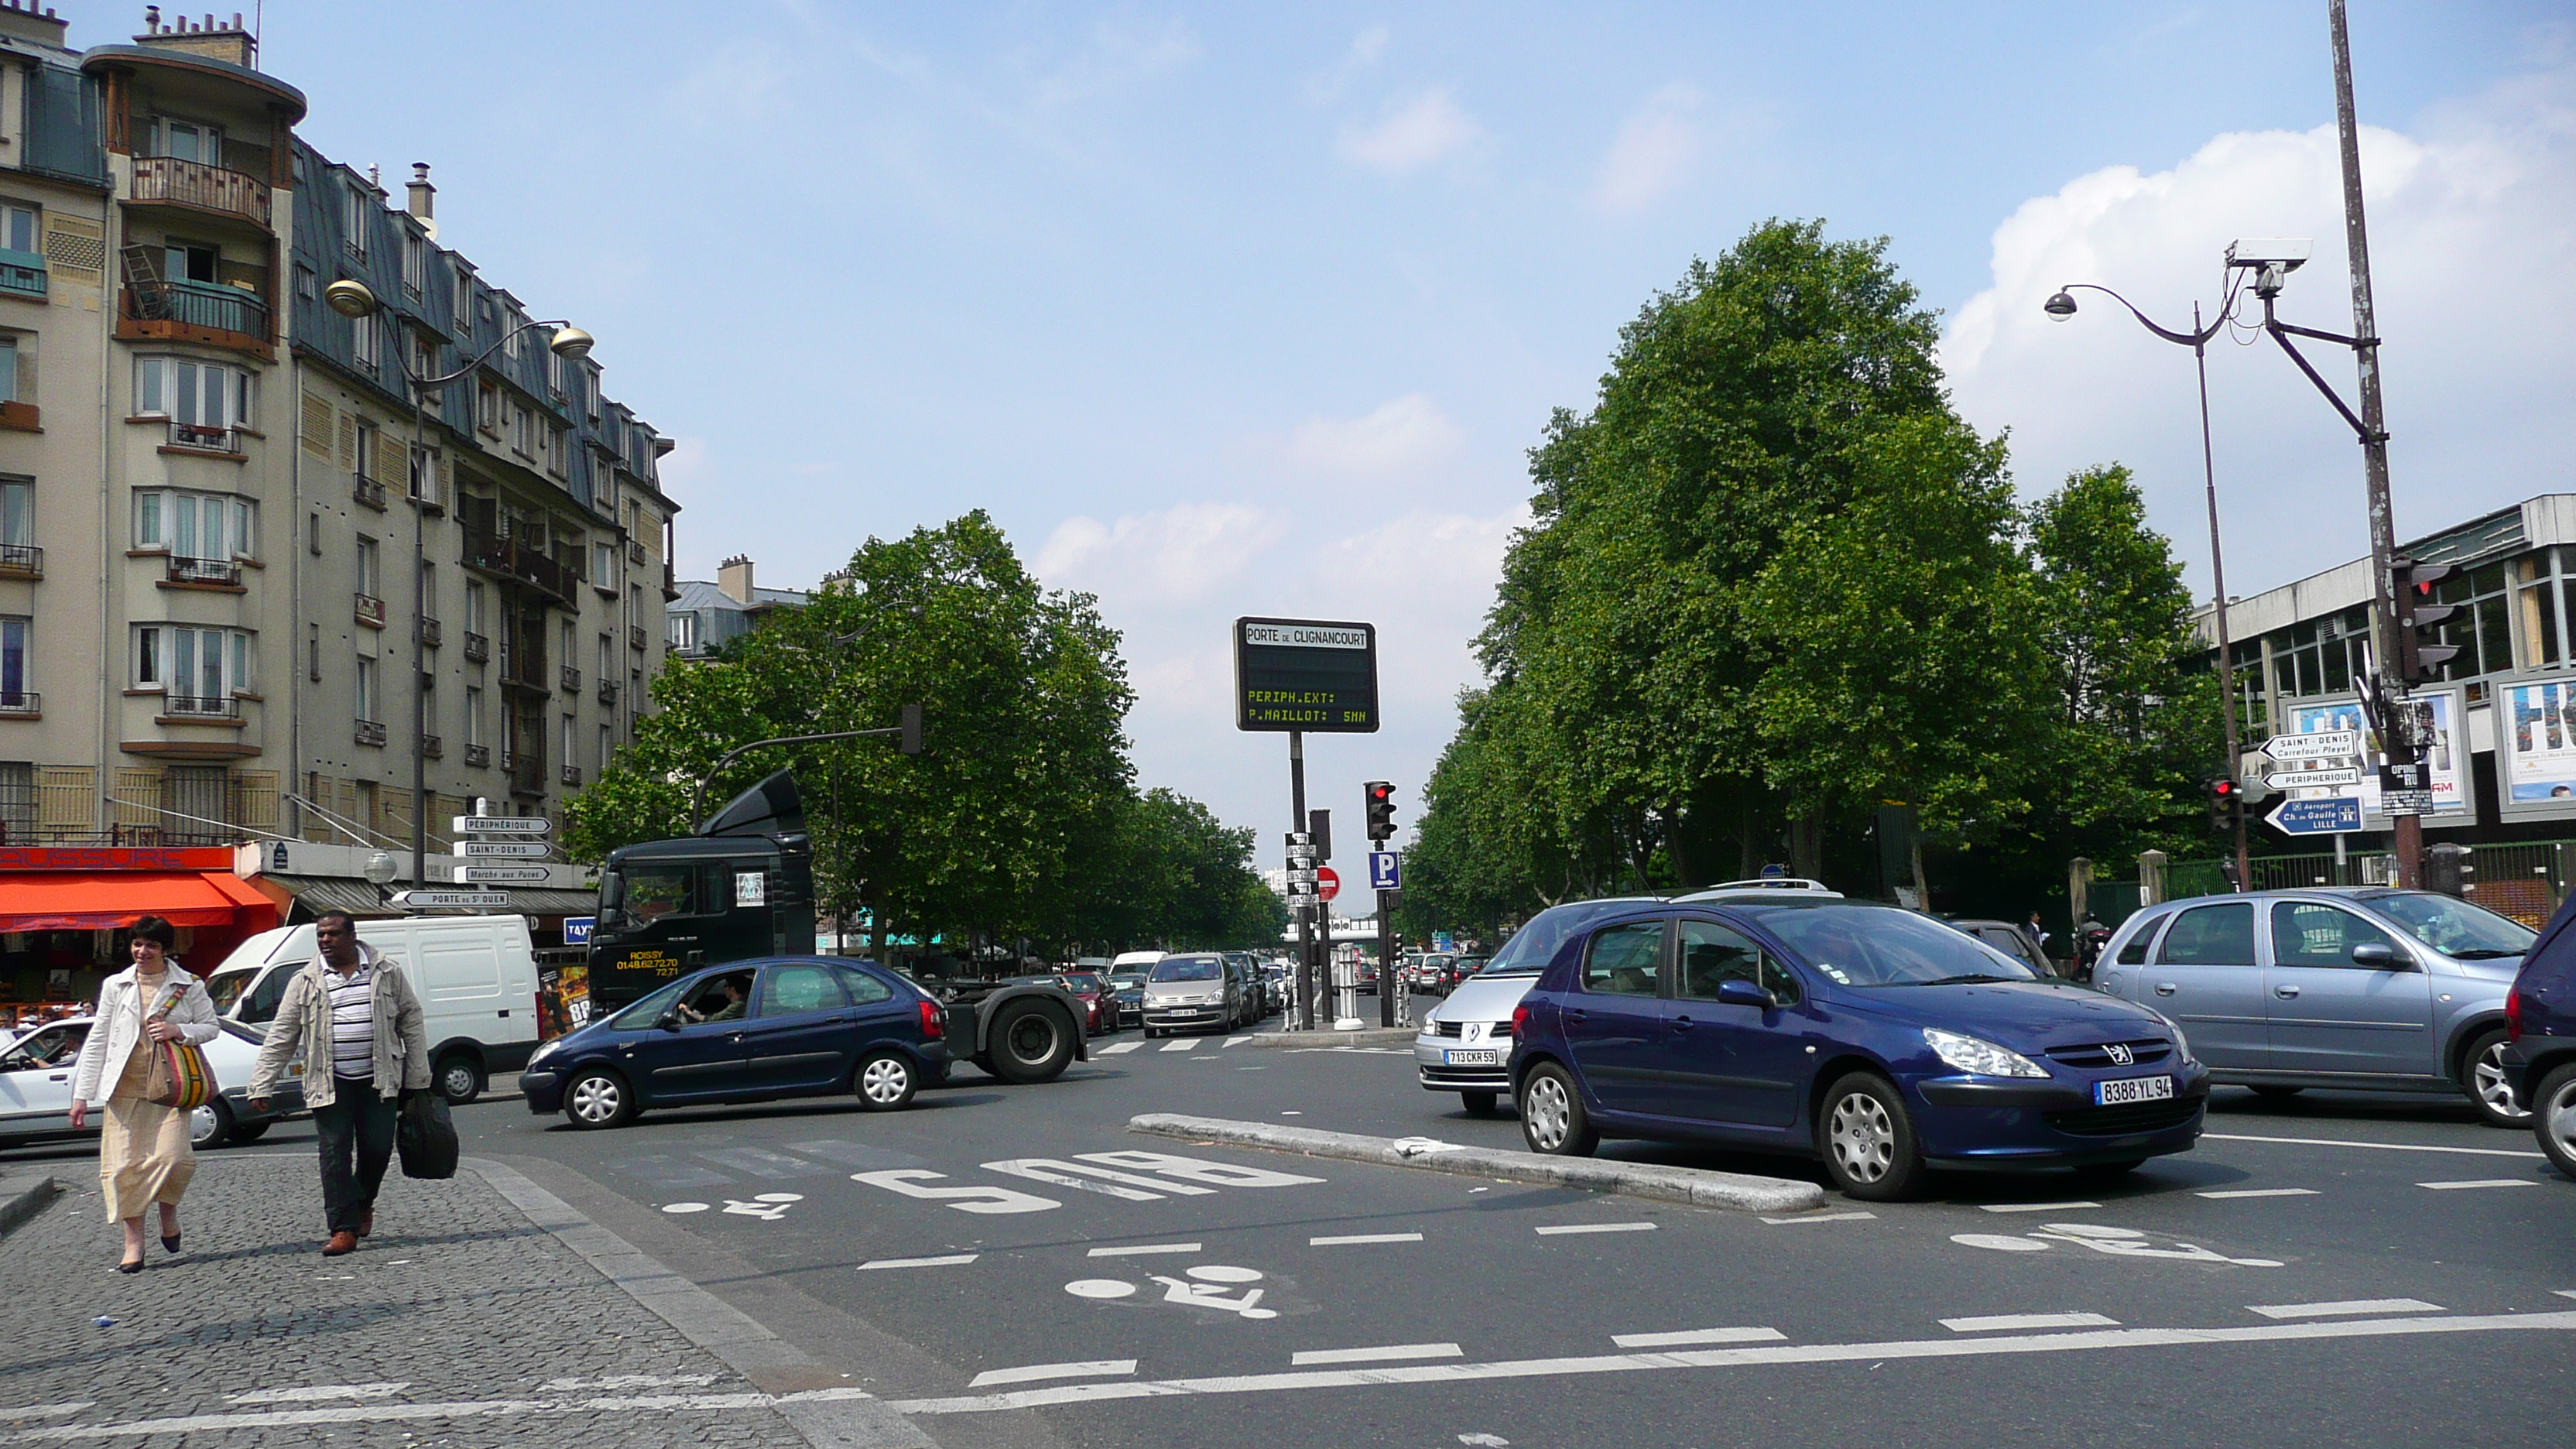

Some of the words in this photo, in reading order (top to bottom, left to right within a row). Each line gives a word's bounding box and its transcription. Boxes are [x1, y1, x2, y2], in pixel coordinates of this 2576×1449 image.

[1247, 629, 1279, 642] PORTE
[1294, 630, 1365, 646] CLIGNANCOURT
[1249, 690, 1334, 704] PERIPH.EXT:
[2277, 748, 2318, 757] Carrefour
[2323, 745, 2349, 755] Pleyel
[2286, 772, 2353, 783] PERIPHERIQUE
[469, 820, 531, 829] PÉRIPHÉRIQUE
[2314, 820, 2337, 829] LILLE
[1378, 855, 1395, 879] P
[471, 869, 497, 879] Marché
[433, 895, 460, 903] PORTE
[483, 895, 505, 903] OUEN
[630, 951, 663, 960] ROISSY
[1451, 1053, 1465, 1062] 713
[1467, 1053, 1482, 1062] CKR
[1484, 1053, 1494, 1062] 59
[2105, 1081, 2136, 1101] 8388
[2139, 1080, 2153, 1098] YL
[2156, 1078, 2170, 1097] 94
[851, 1150, 1327, 1214] BUS
